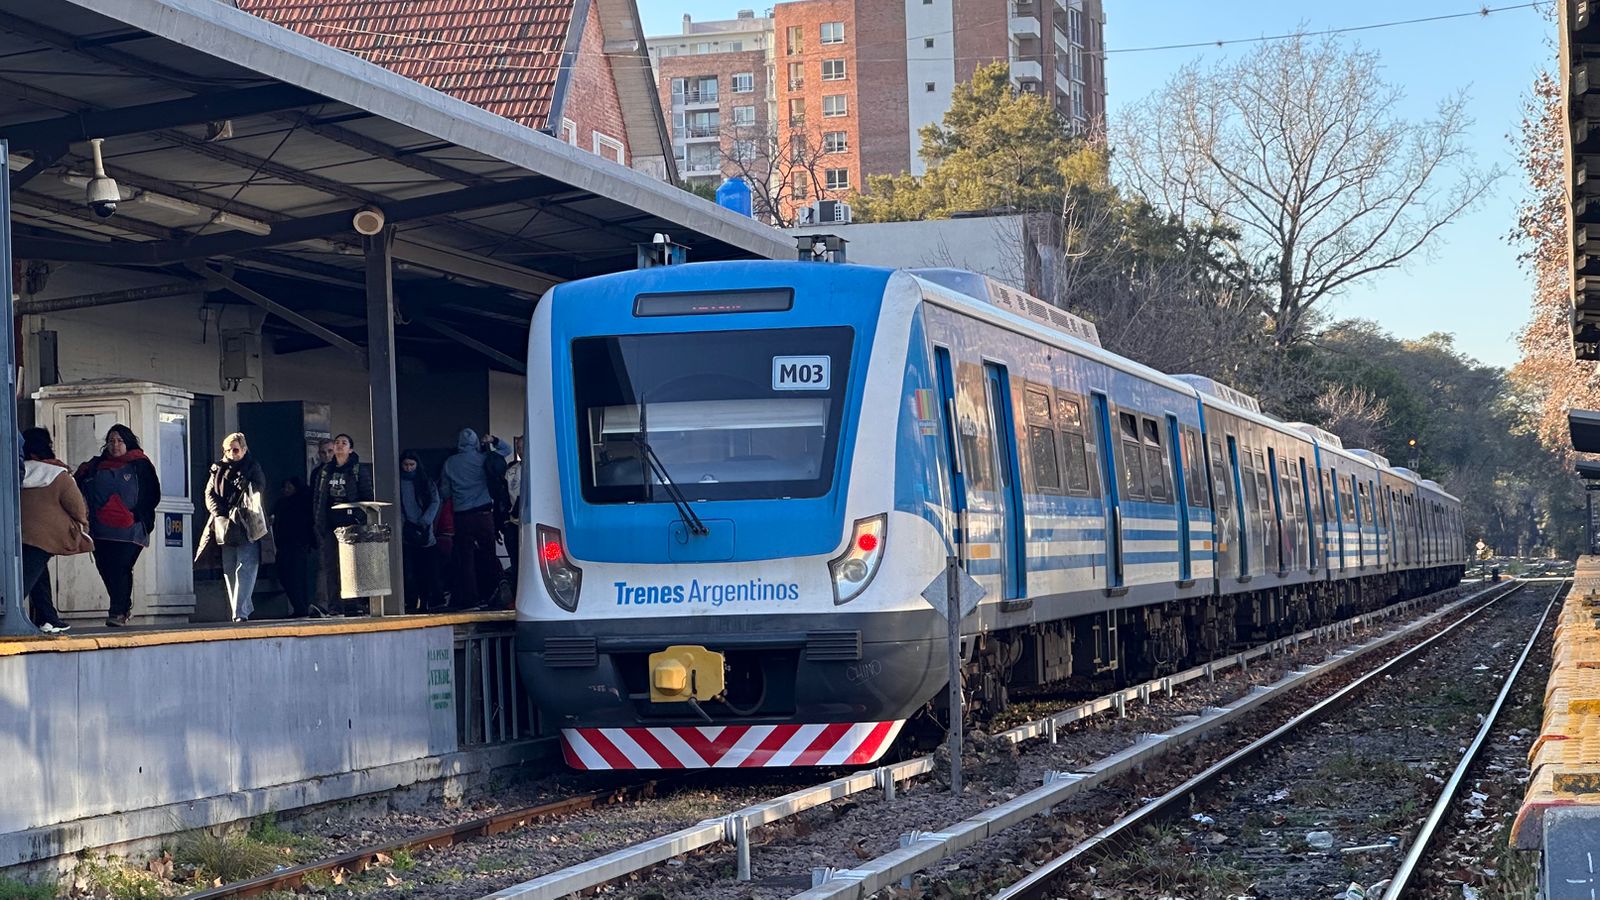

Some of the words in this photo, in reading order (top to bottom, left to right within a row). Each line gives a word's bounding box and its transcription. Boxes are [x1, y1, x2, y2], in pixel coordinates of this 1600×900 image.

[779, 363, 824, 384] M03
[614, 581, 685, 606] Trenes
[688, 577, 799, 607] Argentinos
